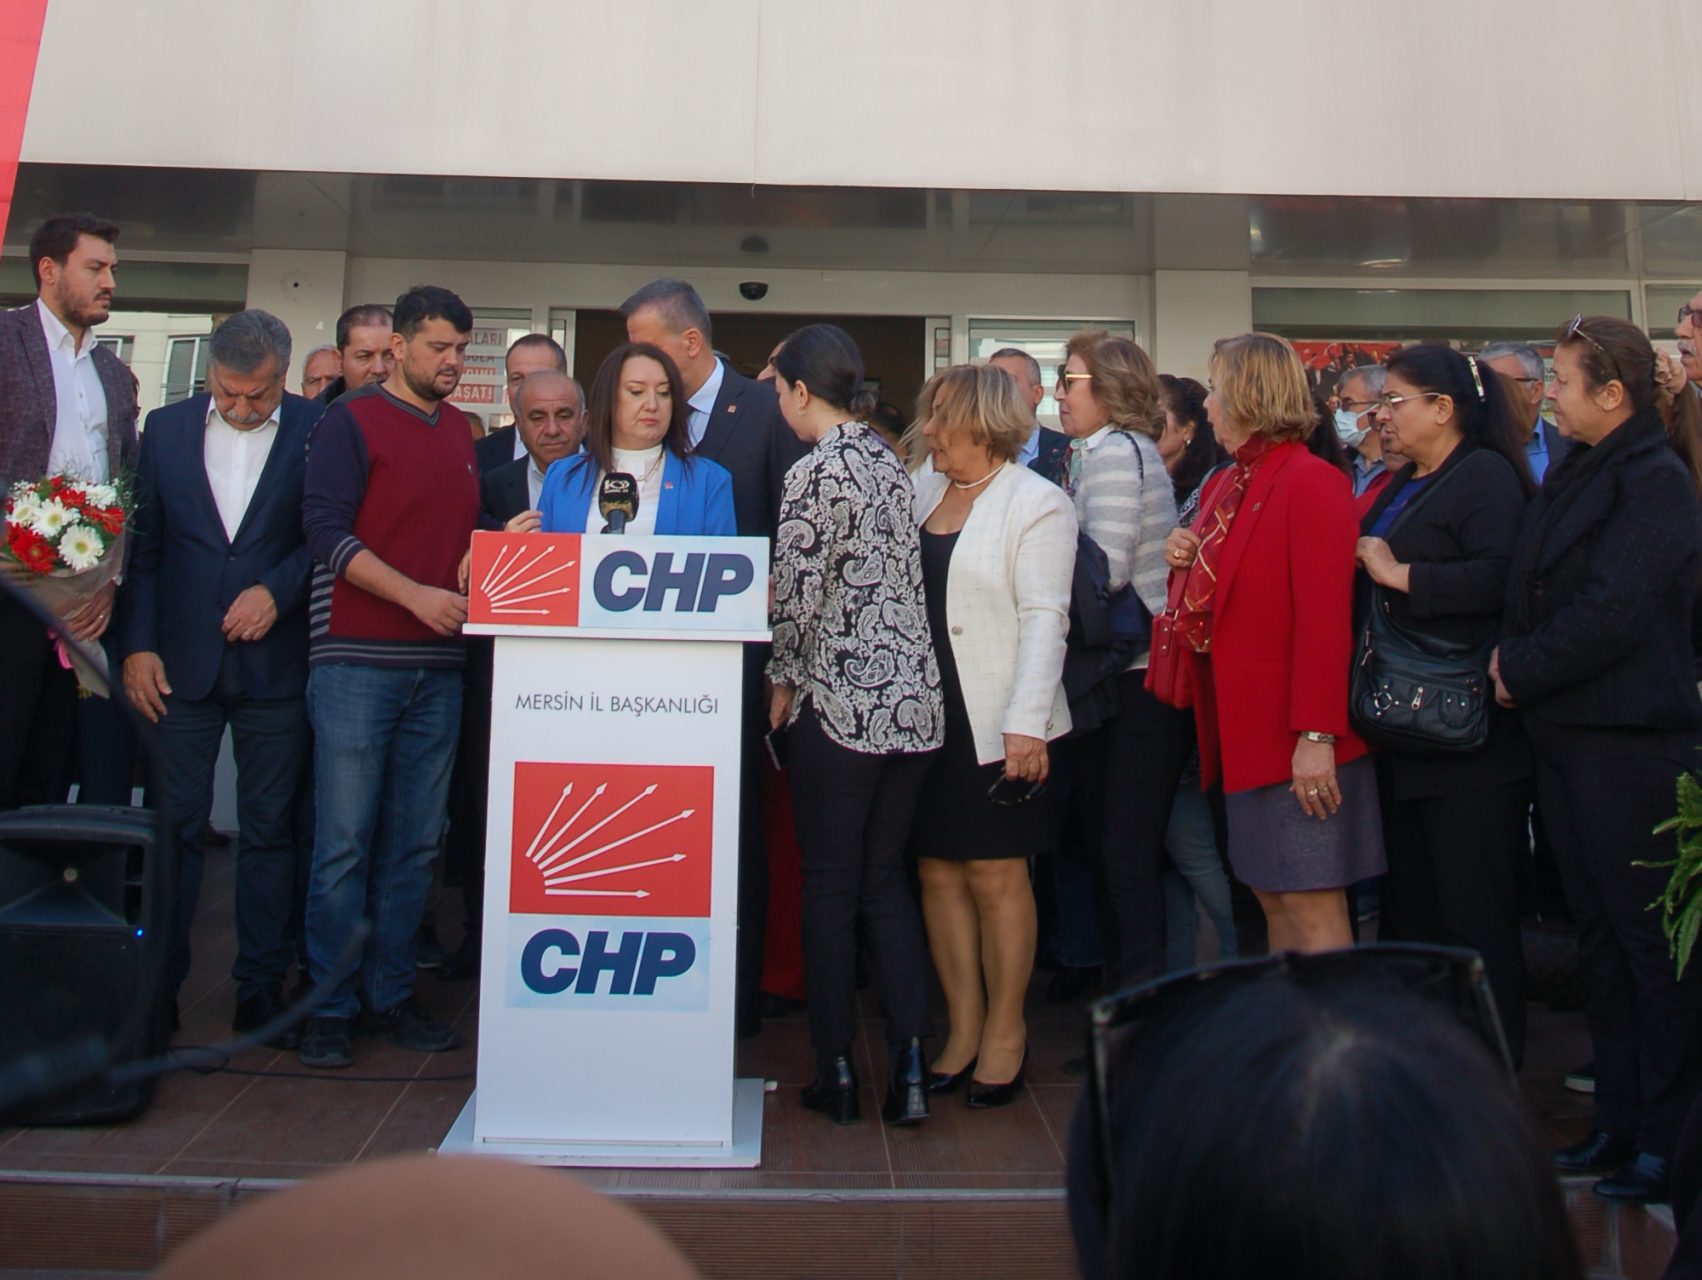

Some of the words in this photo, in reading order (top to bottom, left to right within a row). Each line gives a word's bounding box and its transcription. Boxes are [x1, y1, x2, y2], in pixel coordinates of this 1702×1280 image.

[452, 384, 493, 402] AŞAT!
[593, 550, 754, 613] CHP
[515, 691, 583, 711] MERSİN
[590, 691, 604, 712] İL
[610, 694, 718, 717] BAŞKANLIĞI
[520, 928, 696, 996] CHP
